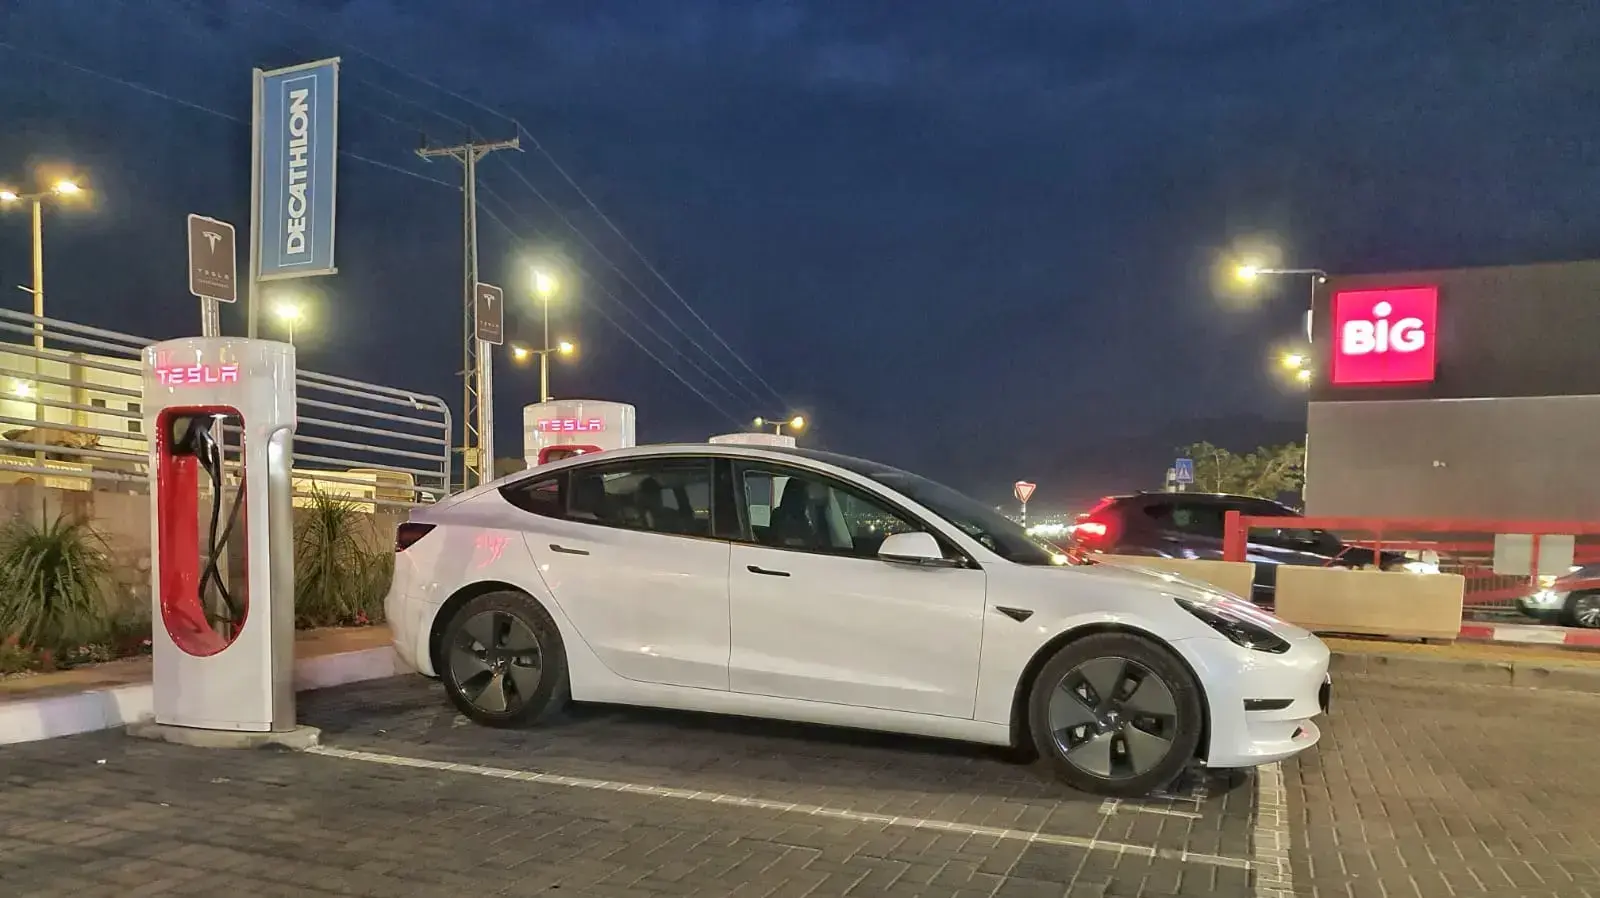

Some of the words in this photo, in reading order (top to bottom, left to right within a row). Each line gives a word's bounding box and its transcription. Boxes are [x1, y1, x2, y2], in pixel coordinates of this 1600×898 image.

[287, 89, 308, 255] DECATHLON
[156, 366, 238, 384] TESLA
[539, 419, 601, 431] TESLA
